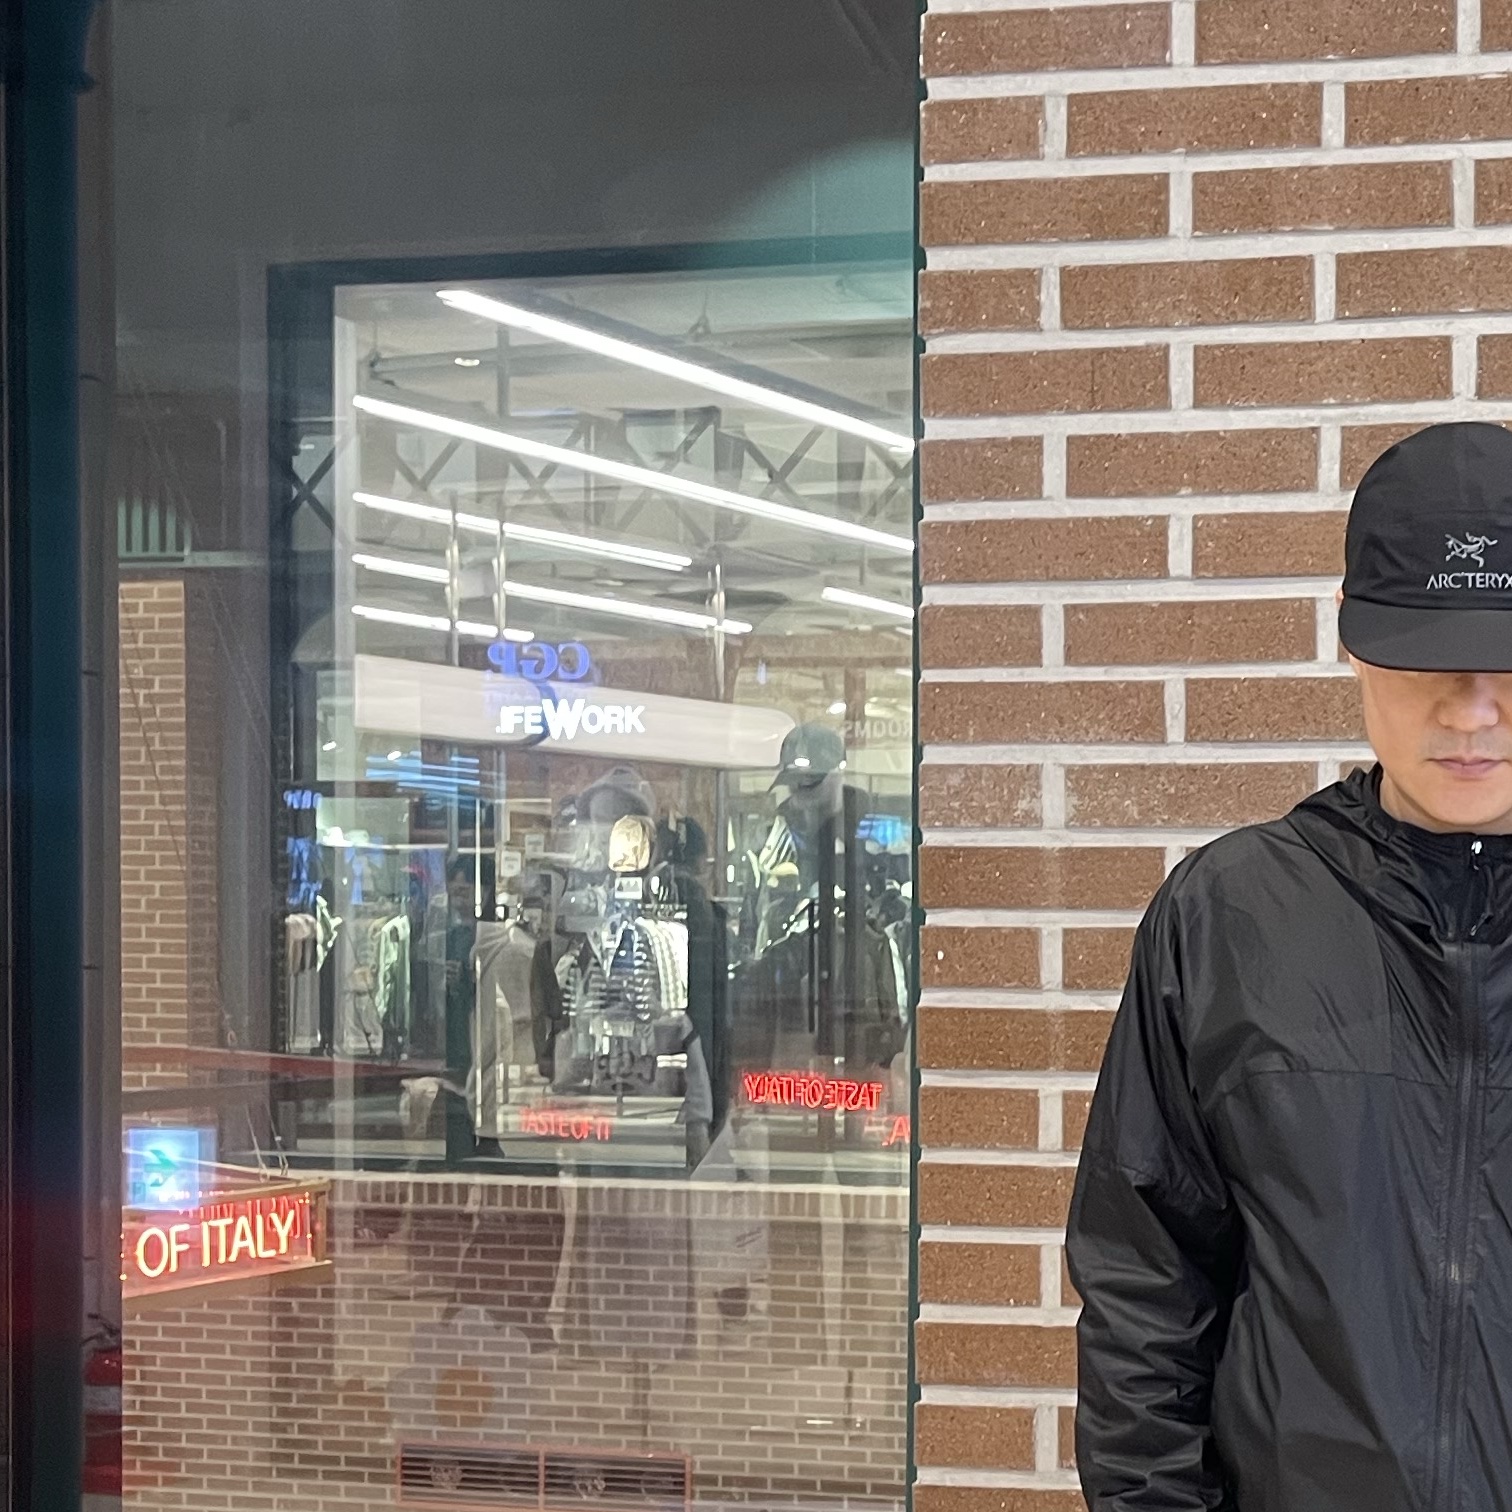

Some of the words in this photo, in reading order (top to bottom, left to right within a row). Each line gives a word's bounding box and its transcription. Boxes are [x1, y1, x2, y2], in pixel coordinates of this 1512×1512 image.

[495, 699, 646, 740] IFEWORK
[136, 1224, 191, 1278] OF
[201, 1209, 296, 1268] ITALY
